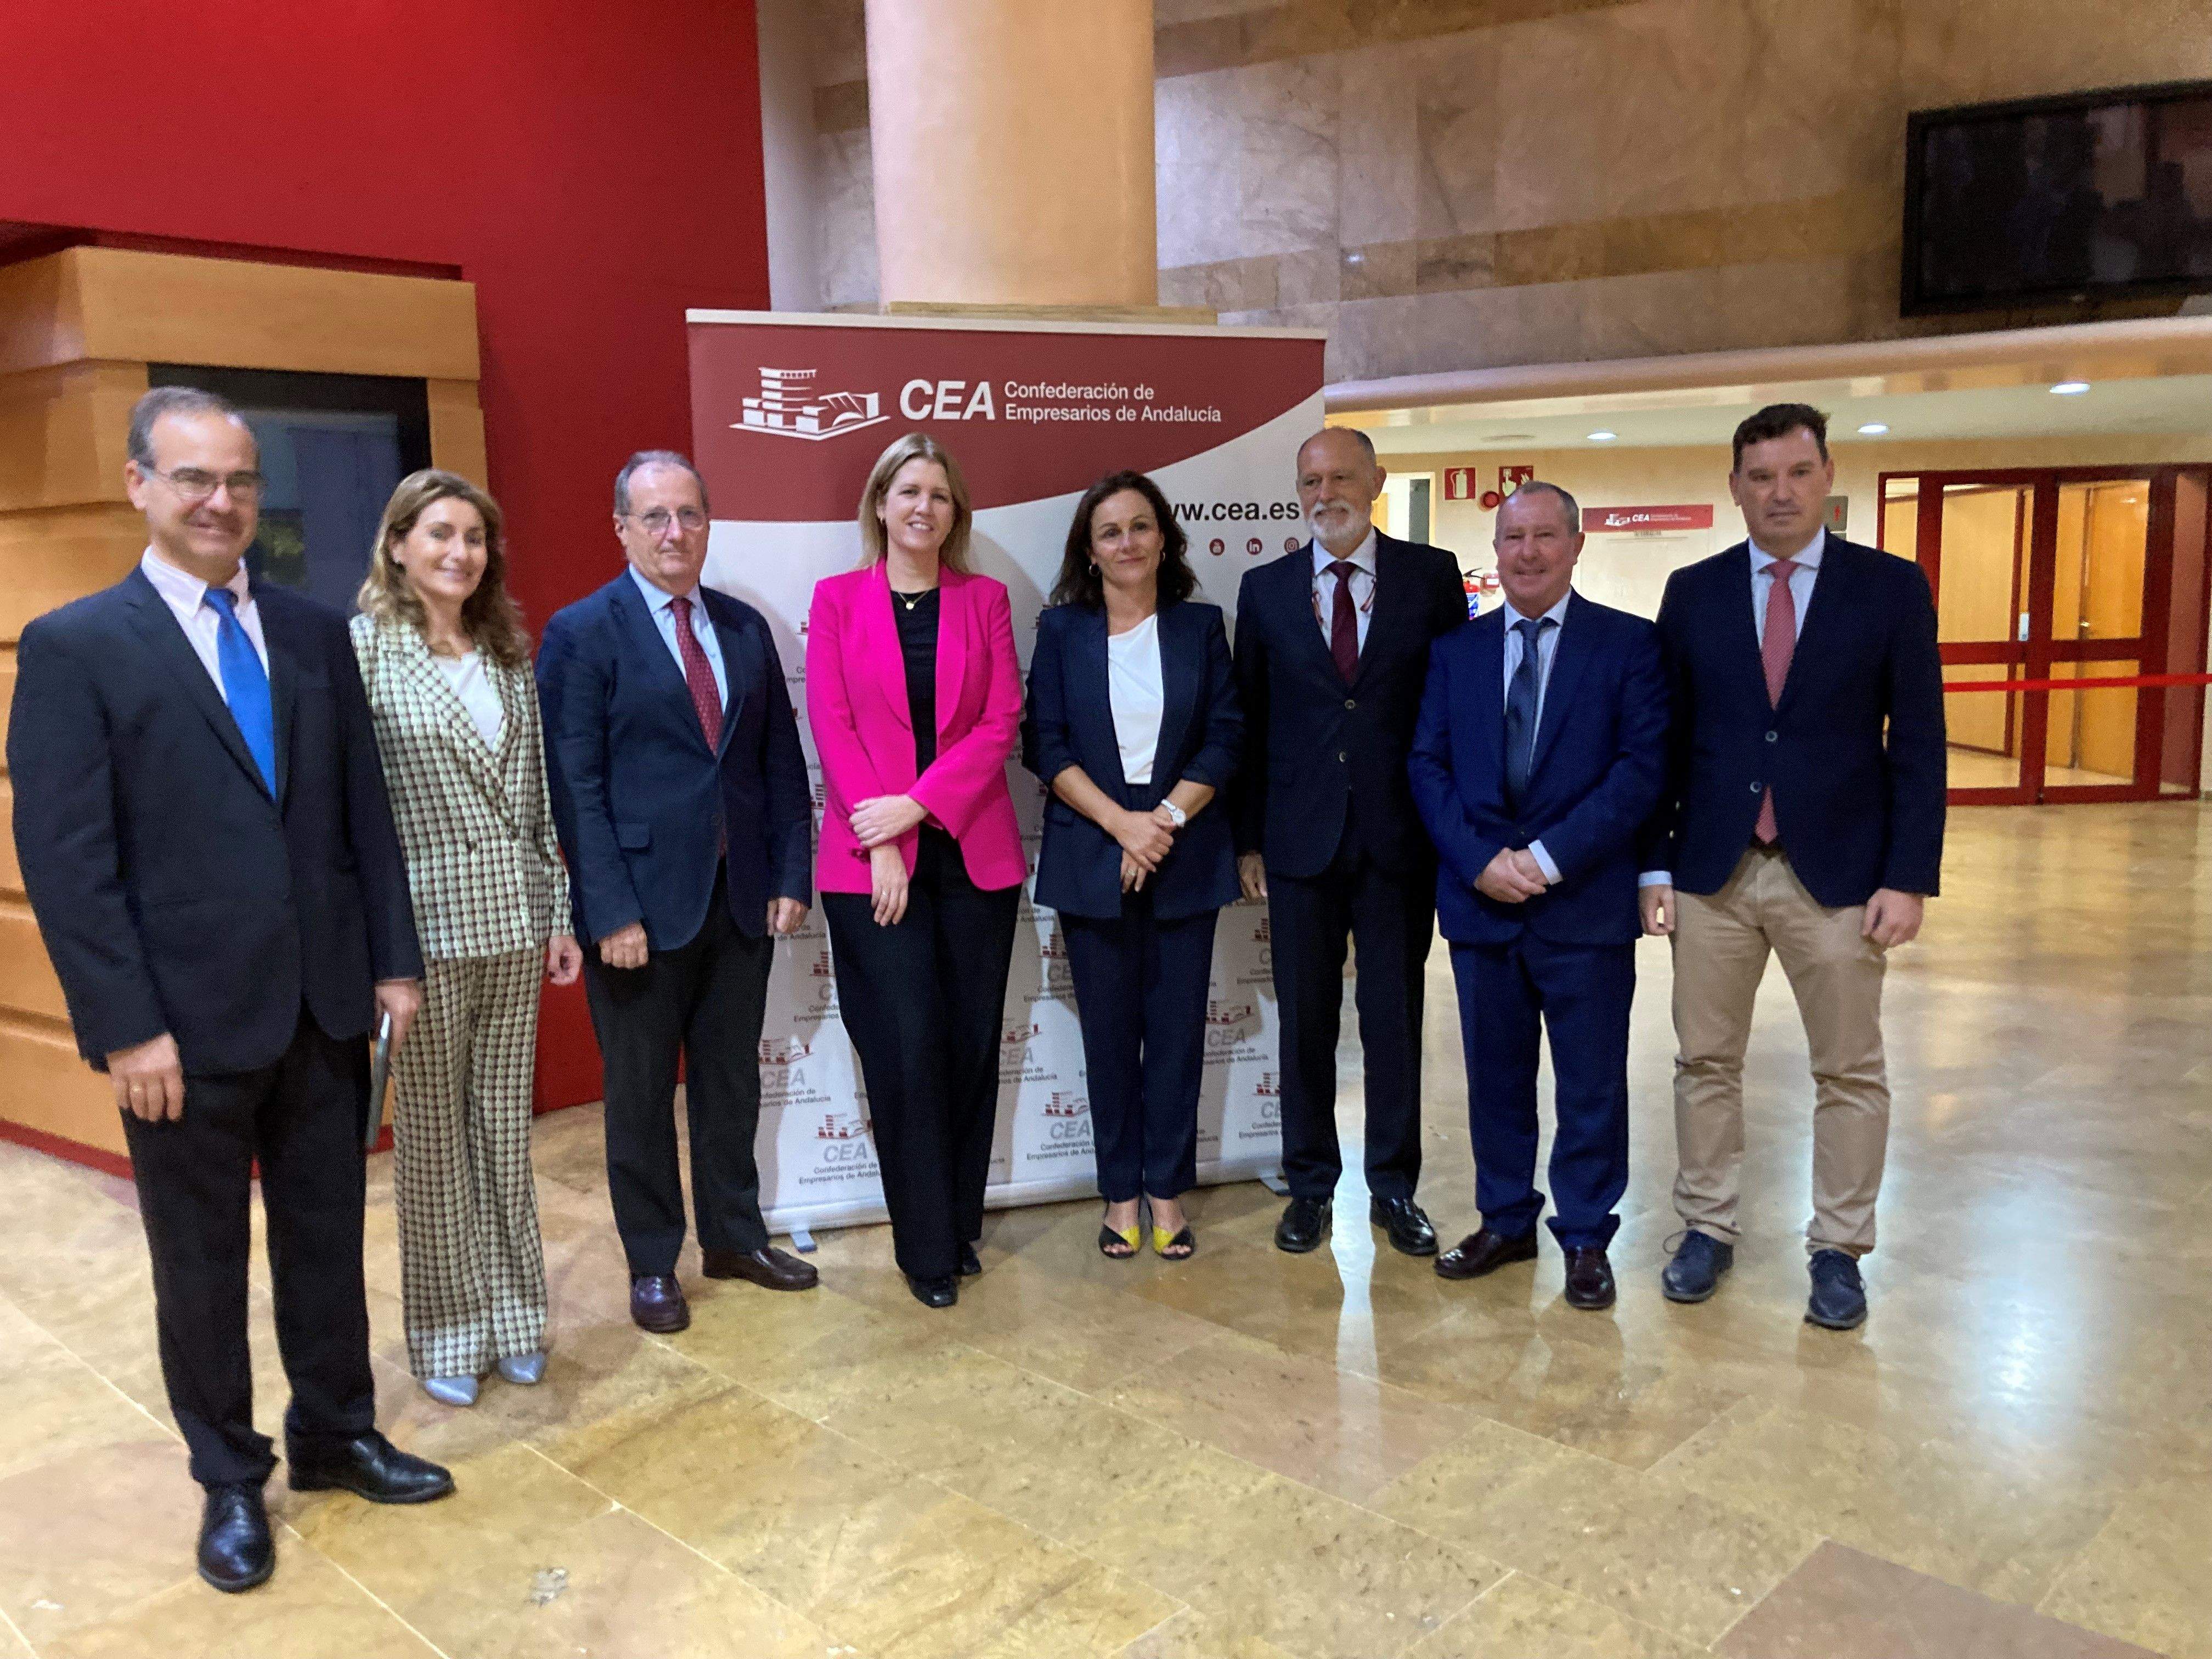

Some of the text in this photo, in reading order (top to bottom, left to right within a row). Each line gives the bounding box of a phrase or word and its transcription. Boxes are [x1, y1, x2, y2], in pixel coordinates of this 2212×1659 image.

[900, 379, 995, 420] CEA
[1005, 381, 1154, 400] Confederación de
[1005, 403, 1221, 424] Empresarios de Andalucía
[1632, 514, 1650, 522] CEA
[1049, 1119, 1091, 1139] CEA
[824, 1142, 868, 1163] CEA
